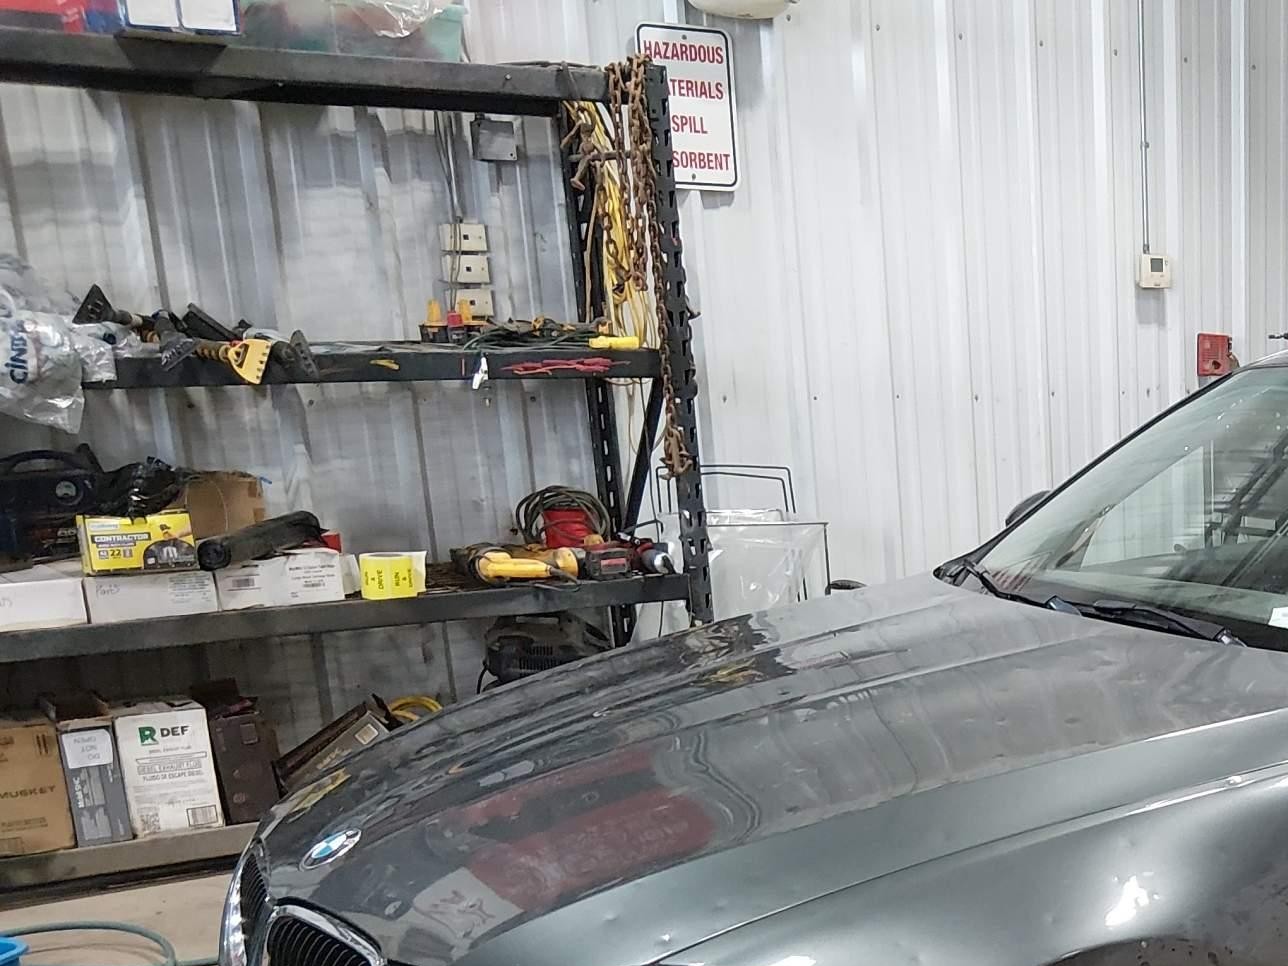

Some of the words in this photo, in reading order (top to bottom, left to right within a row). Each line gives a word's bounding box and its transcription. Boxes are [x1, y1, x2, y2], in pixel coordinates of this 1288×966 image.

[643, 40, 724, 65] HAZARDOUS
[669, 78, 724, 100] TERIALS
[671, 114, 708, 134] SPILL
[671, 150, 731, 171] SORBENT
[160, 725, 189, 738] DEF
